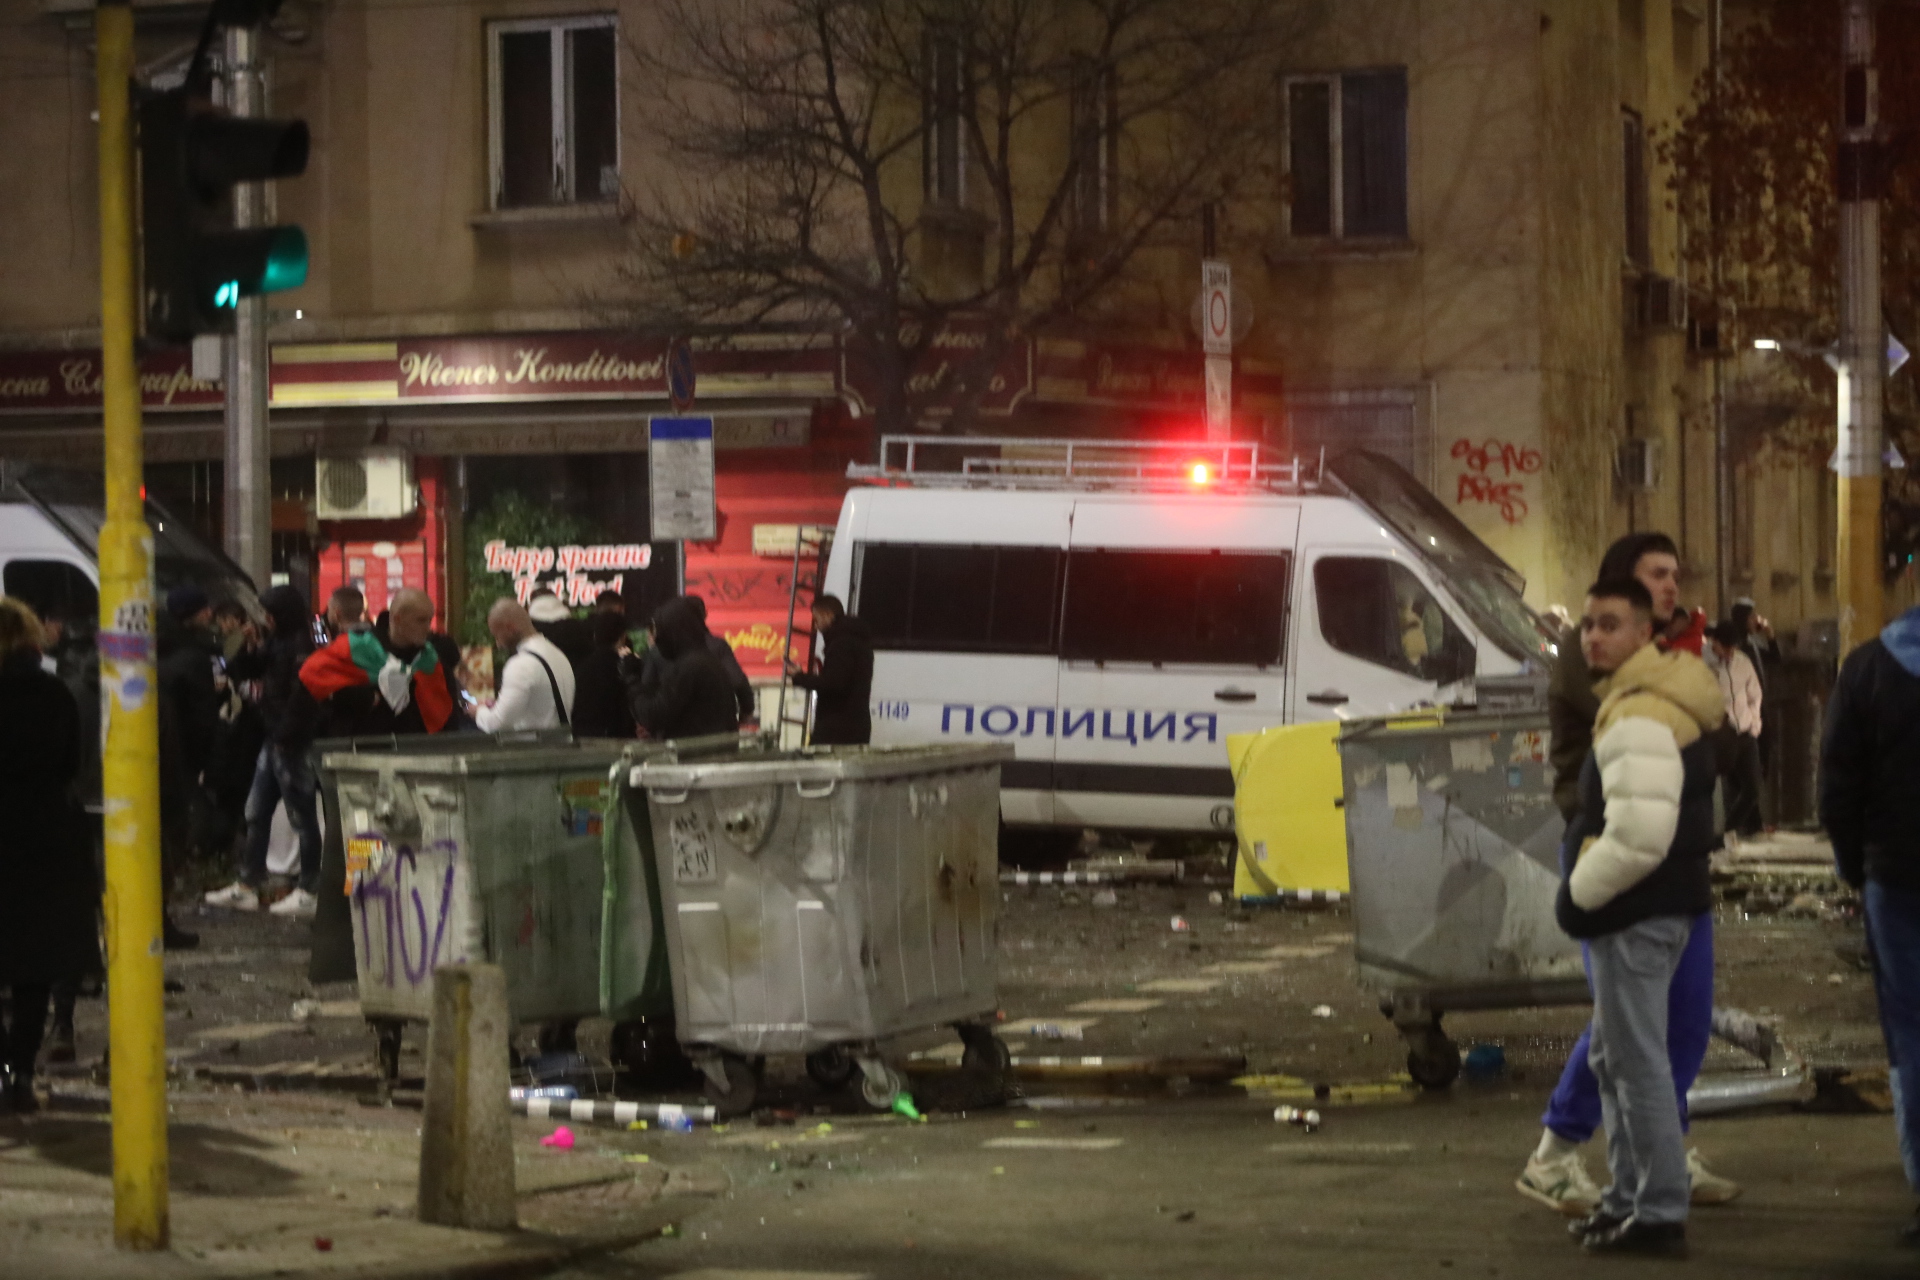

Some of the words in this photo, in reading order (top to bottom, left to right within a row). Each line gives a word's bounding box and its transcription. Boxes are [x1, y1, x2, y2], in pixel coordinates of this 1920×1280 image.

[400, 351, 499, 387] Wiener
[505, 347, 663, 385] Konditorei
[941, 703, 1217, 746] ПОЛИЦИЯ
